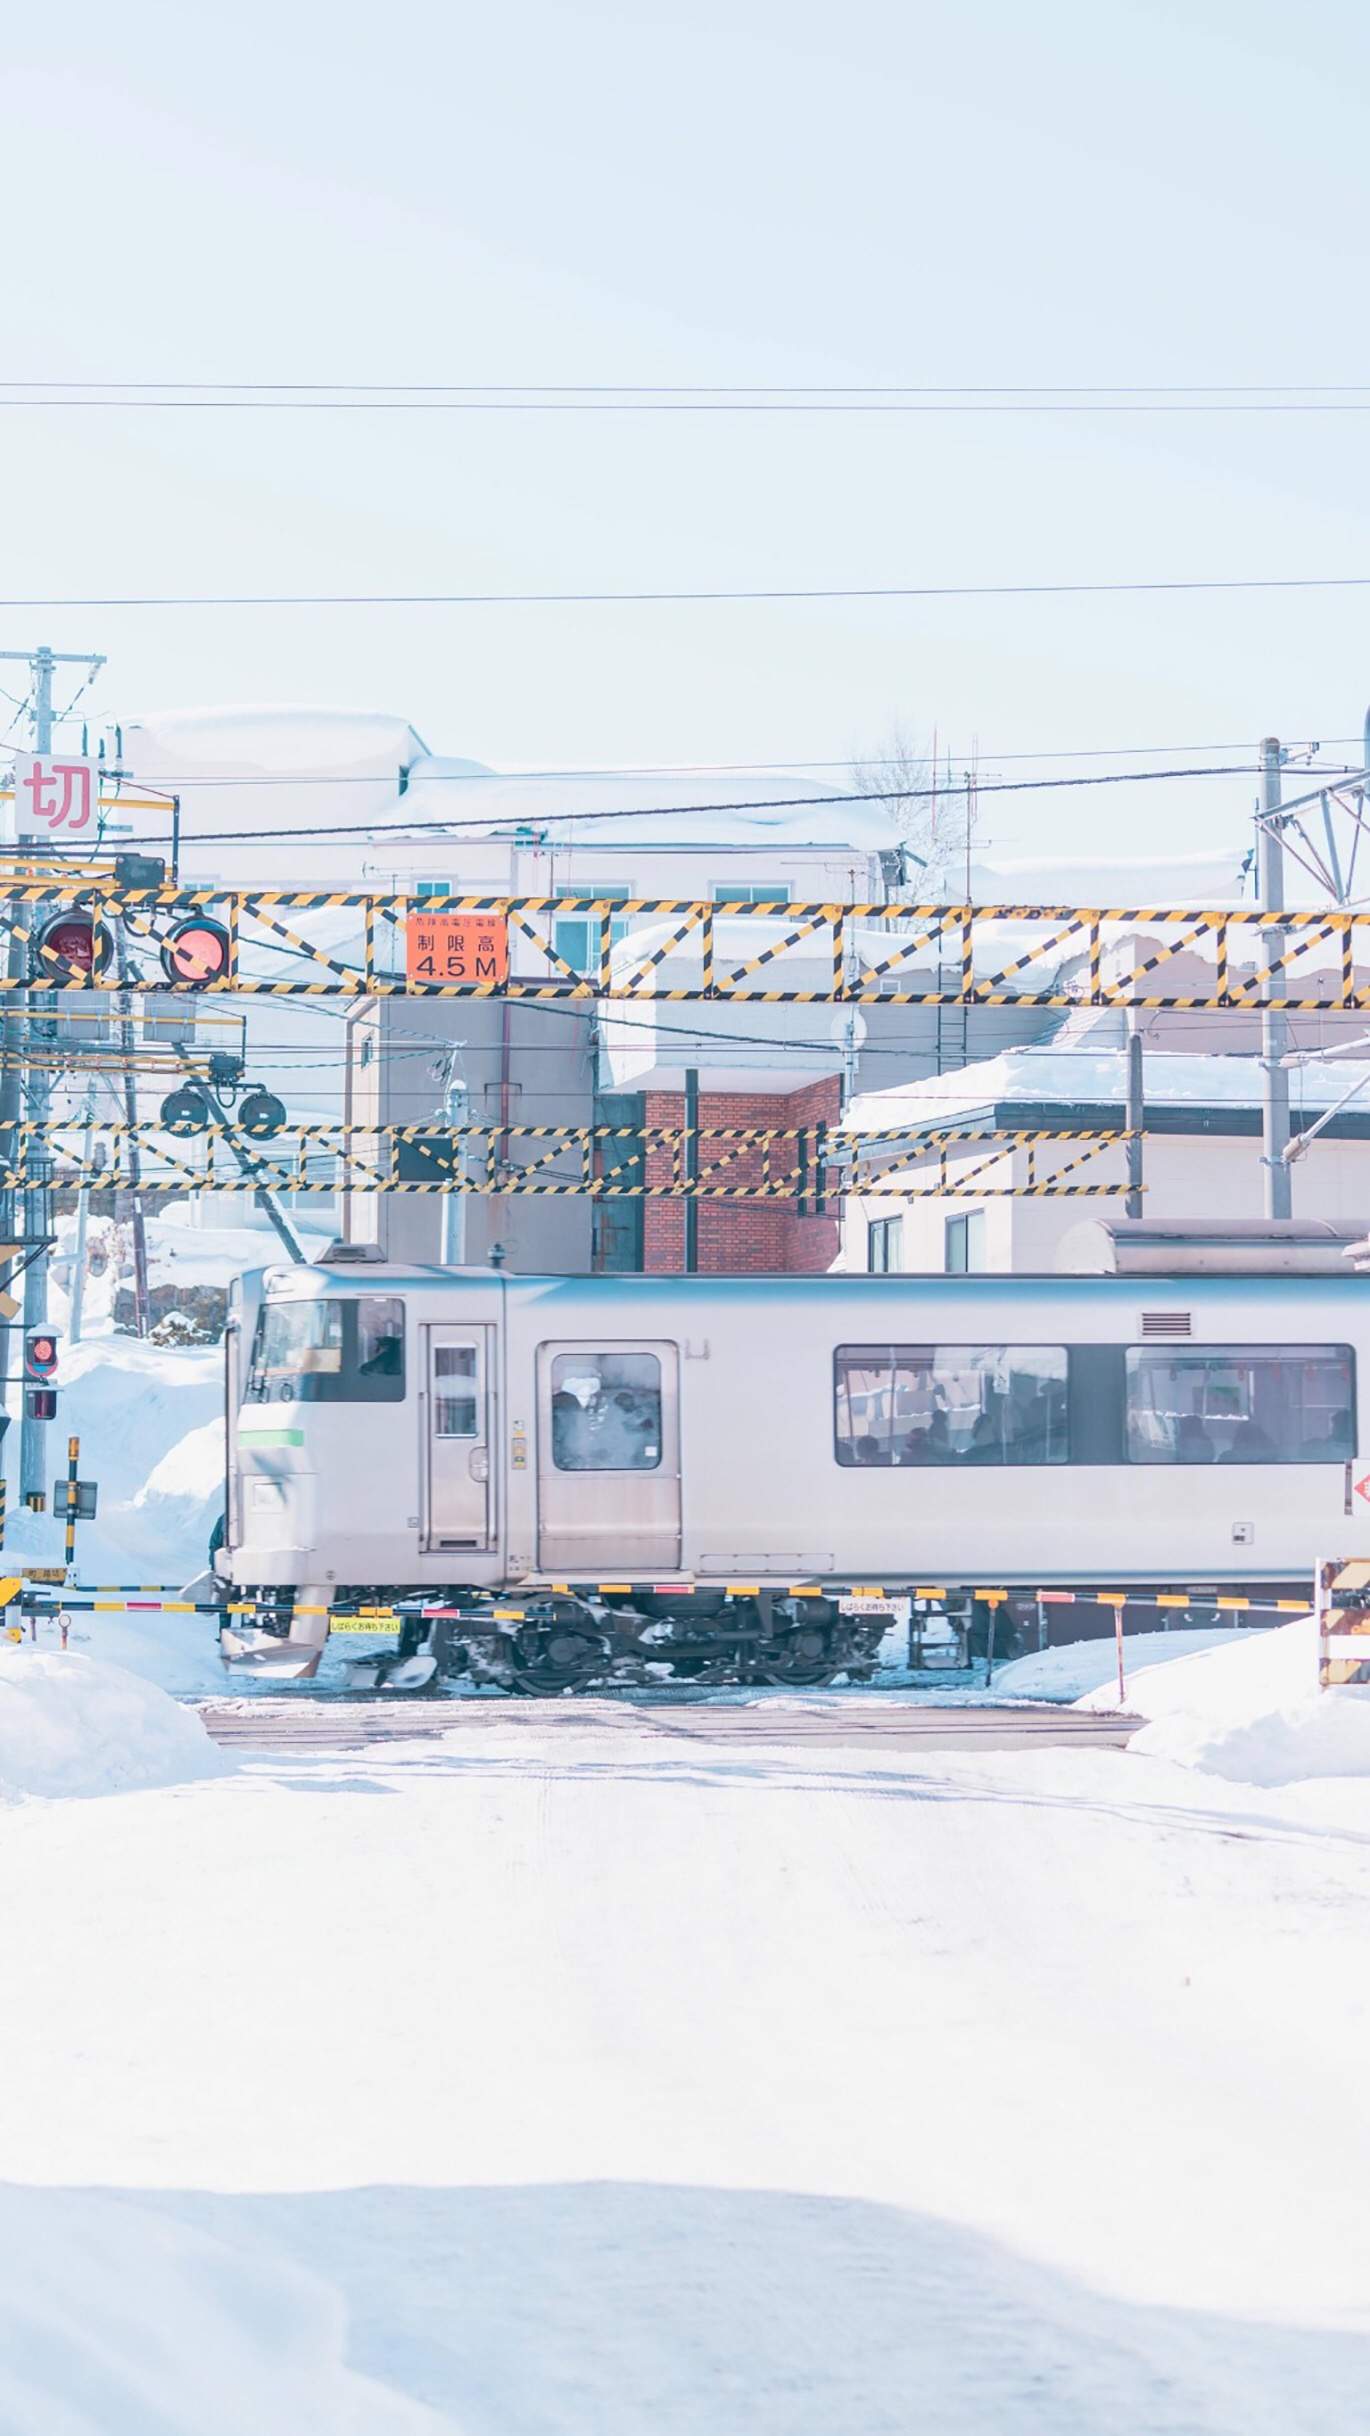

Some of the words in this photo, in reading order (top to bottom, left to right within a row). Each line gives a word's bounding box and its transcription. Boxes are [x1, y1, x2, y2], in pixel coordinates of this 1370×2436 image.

[23, 761, 90, 829] 切
[418, 934, 495, 953] 制限高
